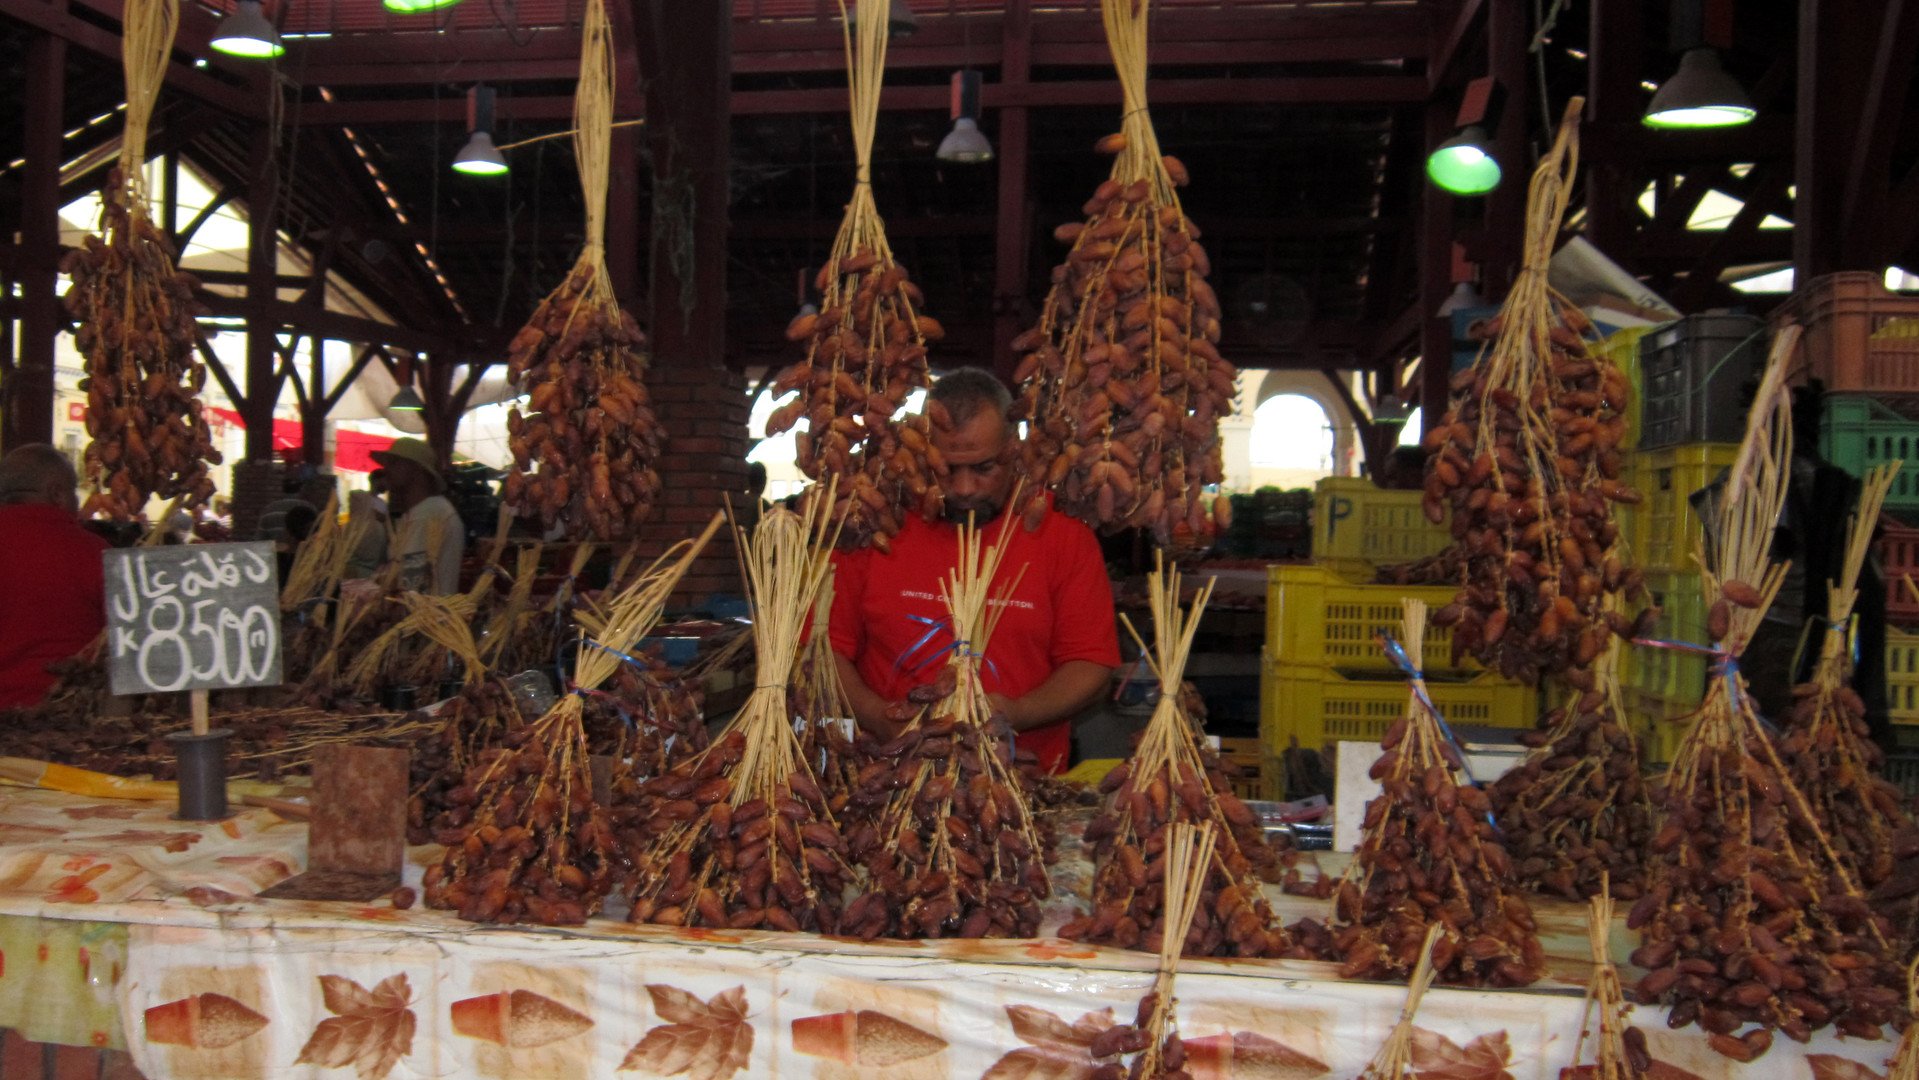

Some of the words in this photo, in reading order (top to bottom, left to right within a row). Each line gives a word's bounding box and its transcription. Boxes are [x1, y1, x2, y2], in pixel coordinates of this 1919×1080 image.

[902, 590, 935, 600] UNITED
[987, 598, 1035, 609] BTTON
[138, 595, 276, 692] 8500
